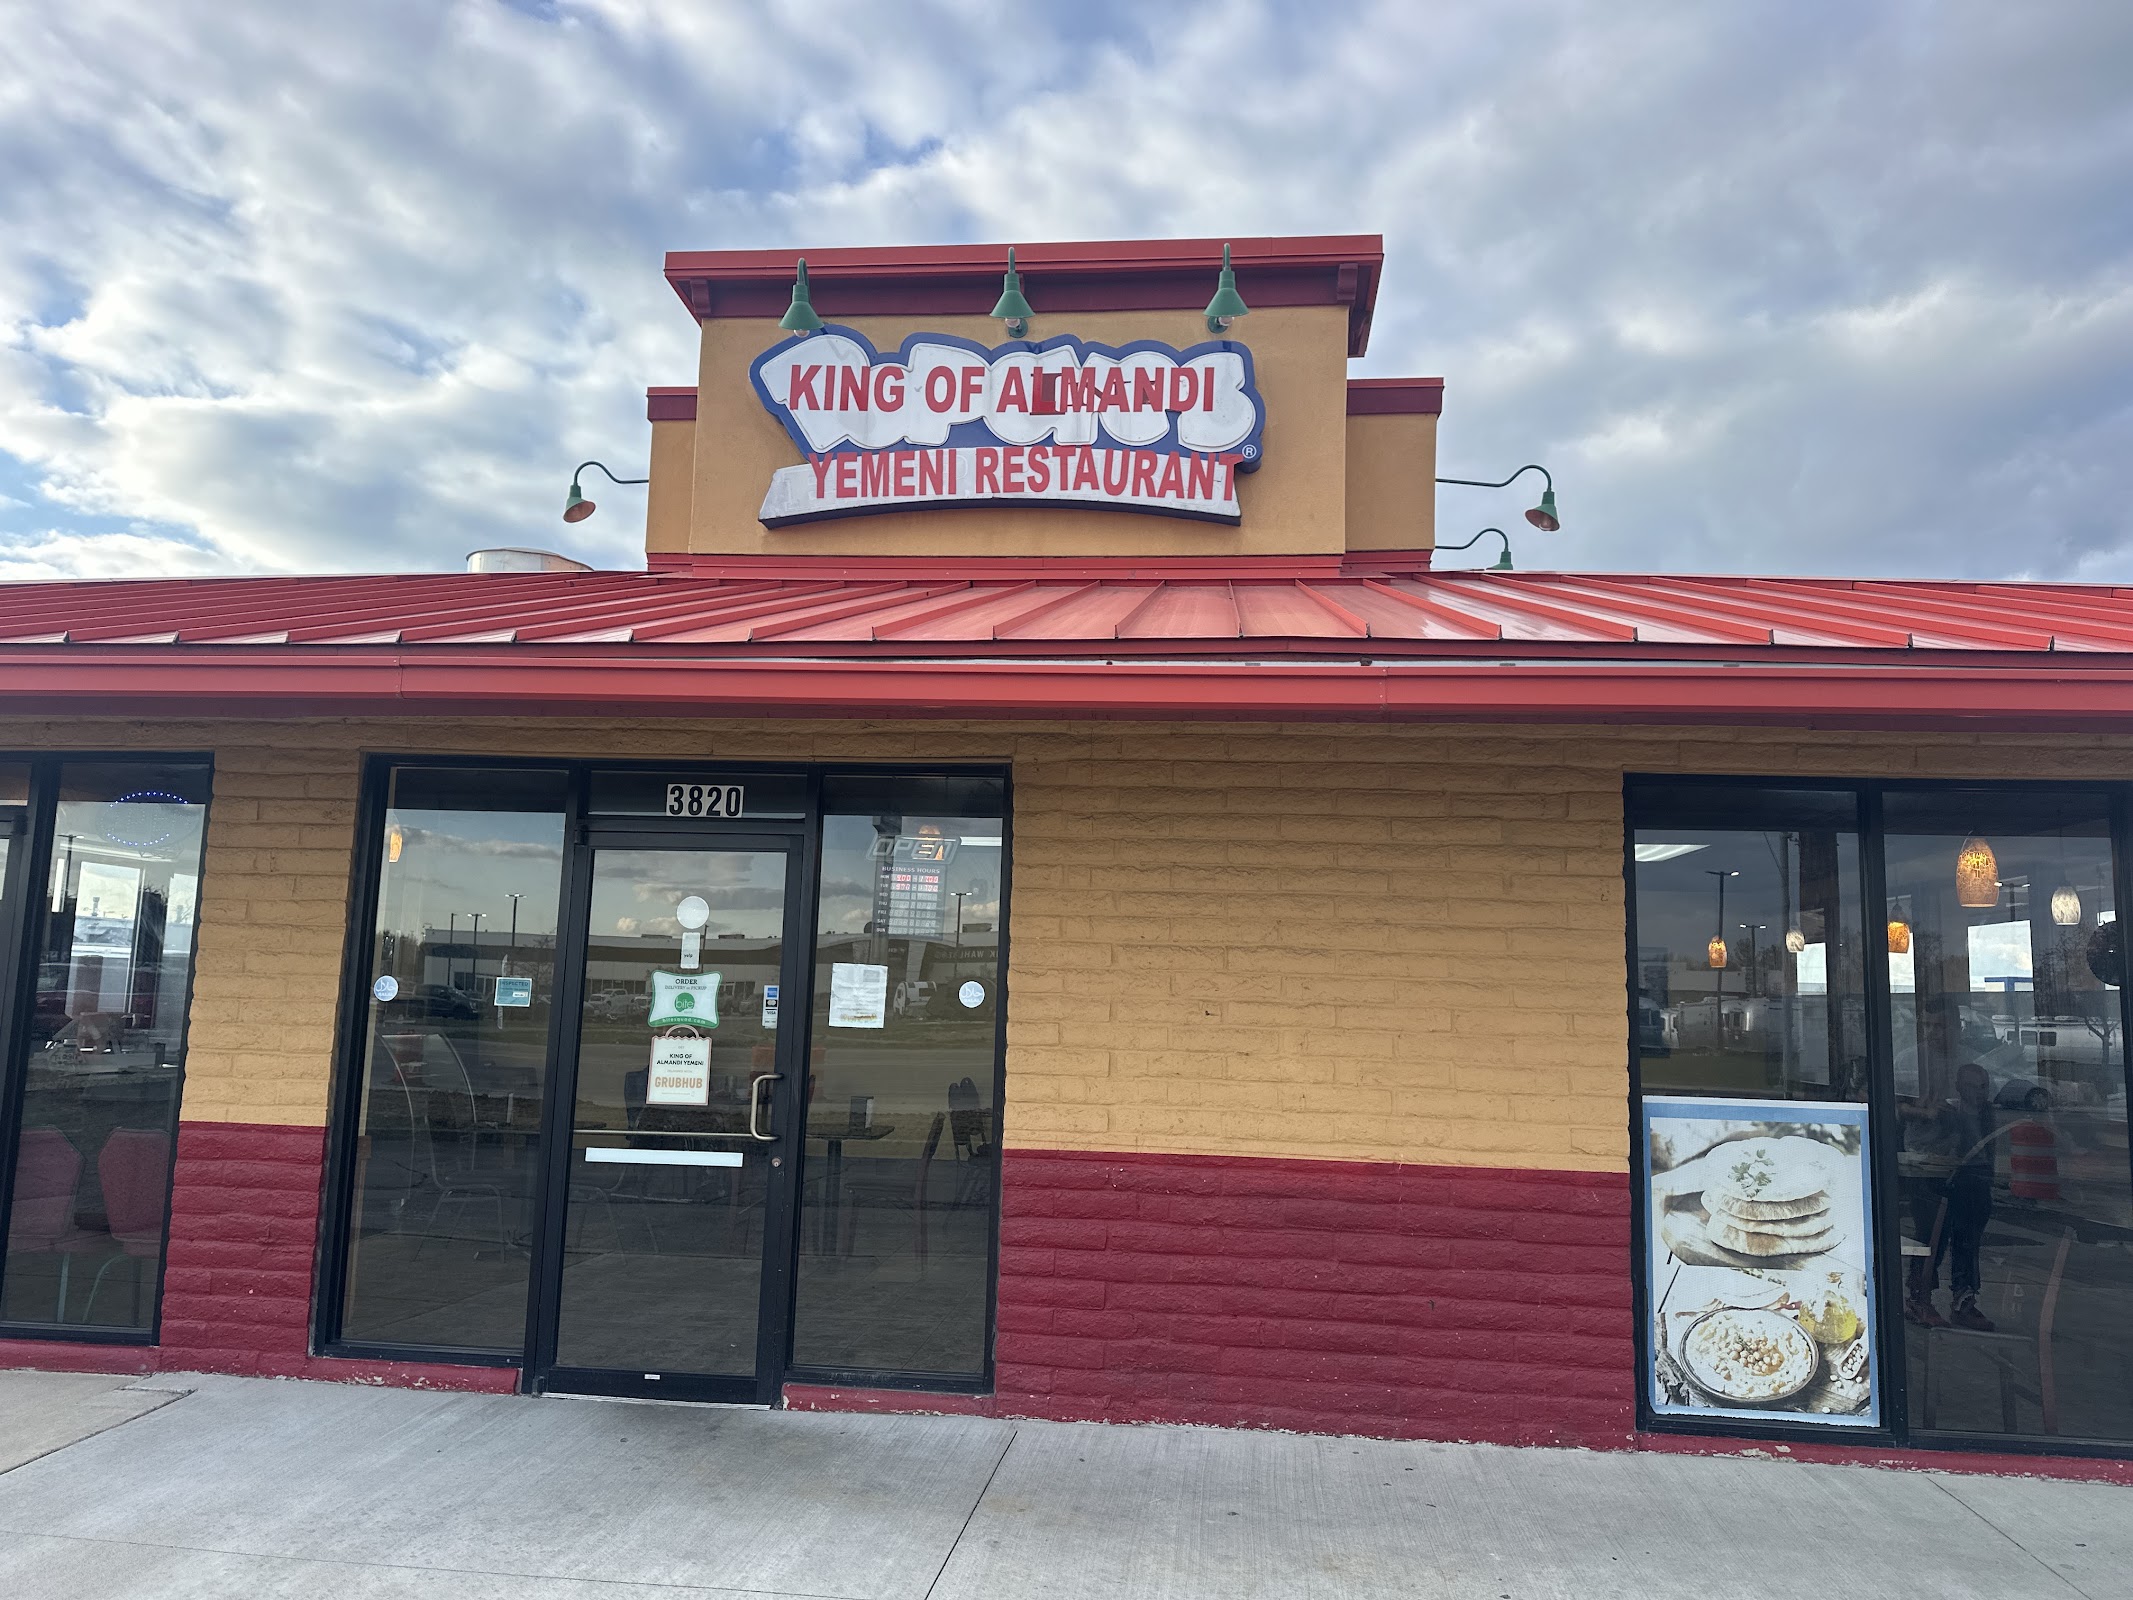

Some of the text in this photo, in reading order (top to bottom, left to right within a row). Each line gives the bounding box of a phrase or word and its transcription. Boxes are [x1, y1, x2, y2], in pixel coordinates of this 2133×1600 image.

[789, 364, 1214, 413] KING OF ALMANDI
[808, 445, 1244, 501] YEMENI RESTAURANT
[668, 785, 741, 817] 3820
[872, 837, 953, 861] OPEN
[881, 866, 915, 874] BUSINESS
[375, 979, 396, 992] حلال
[960, 985, 983, 998] حلال
[675, 997, 694, 1009] bite
[662, 1017, 706, 1025] bitesquad.com
[655, 1076, 703, 1089] GRUBHUB
